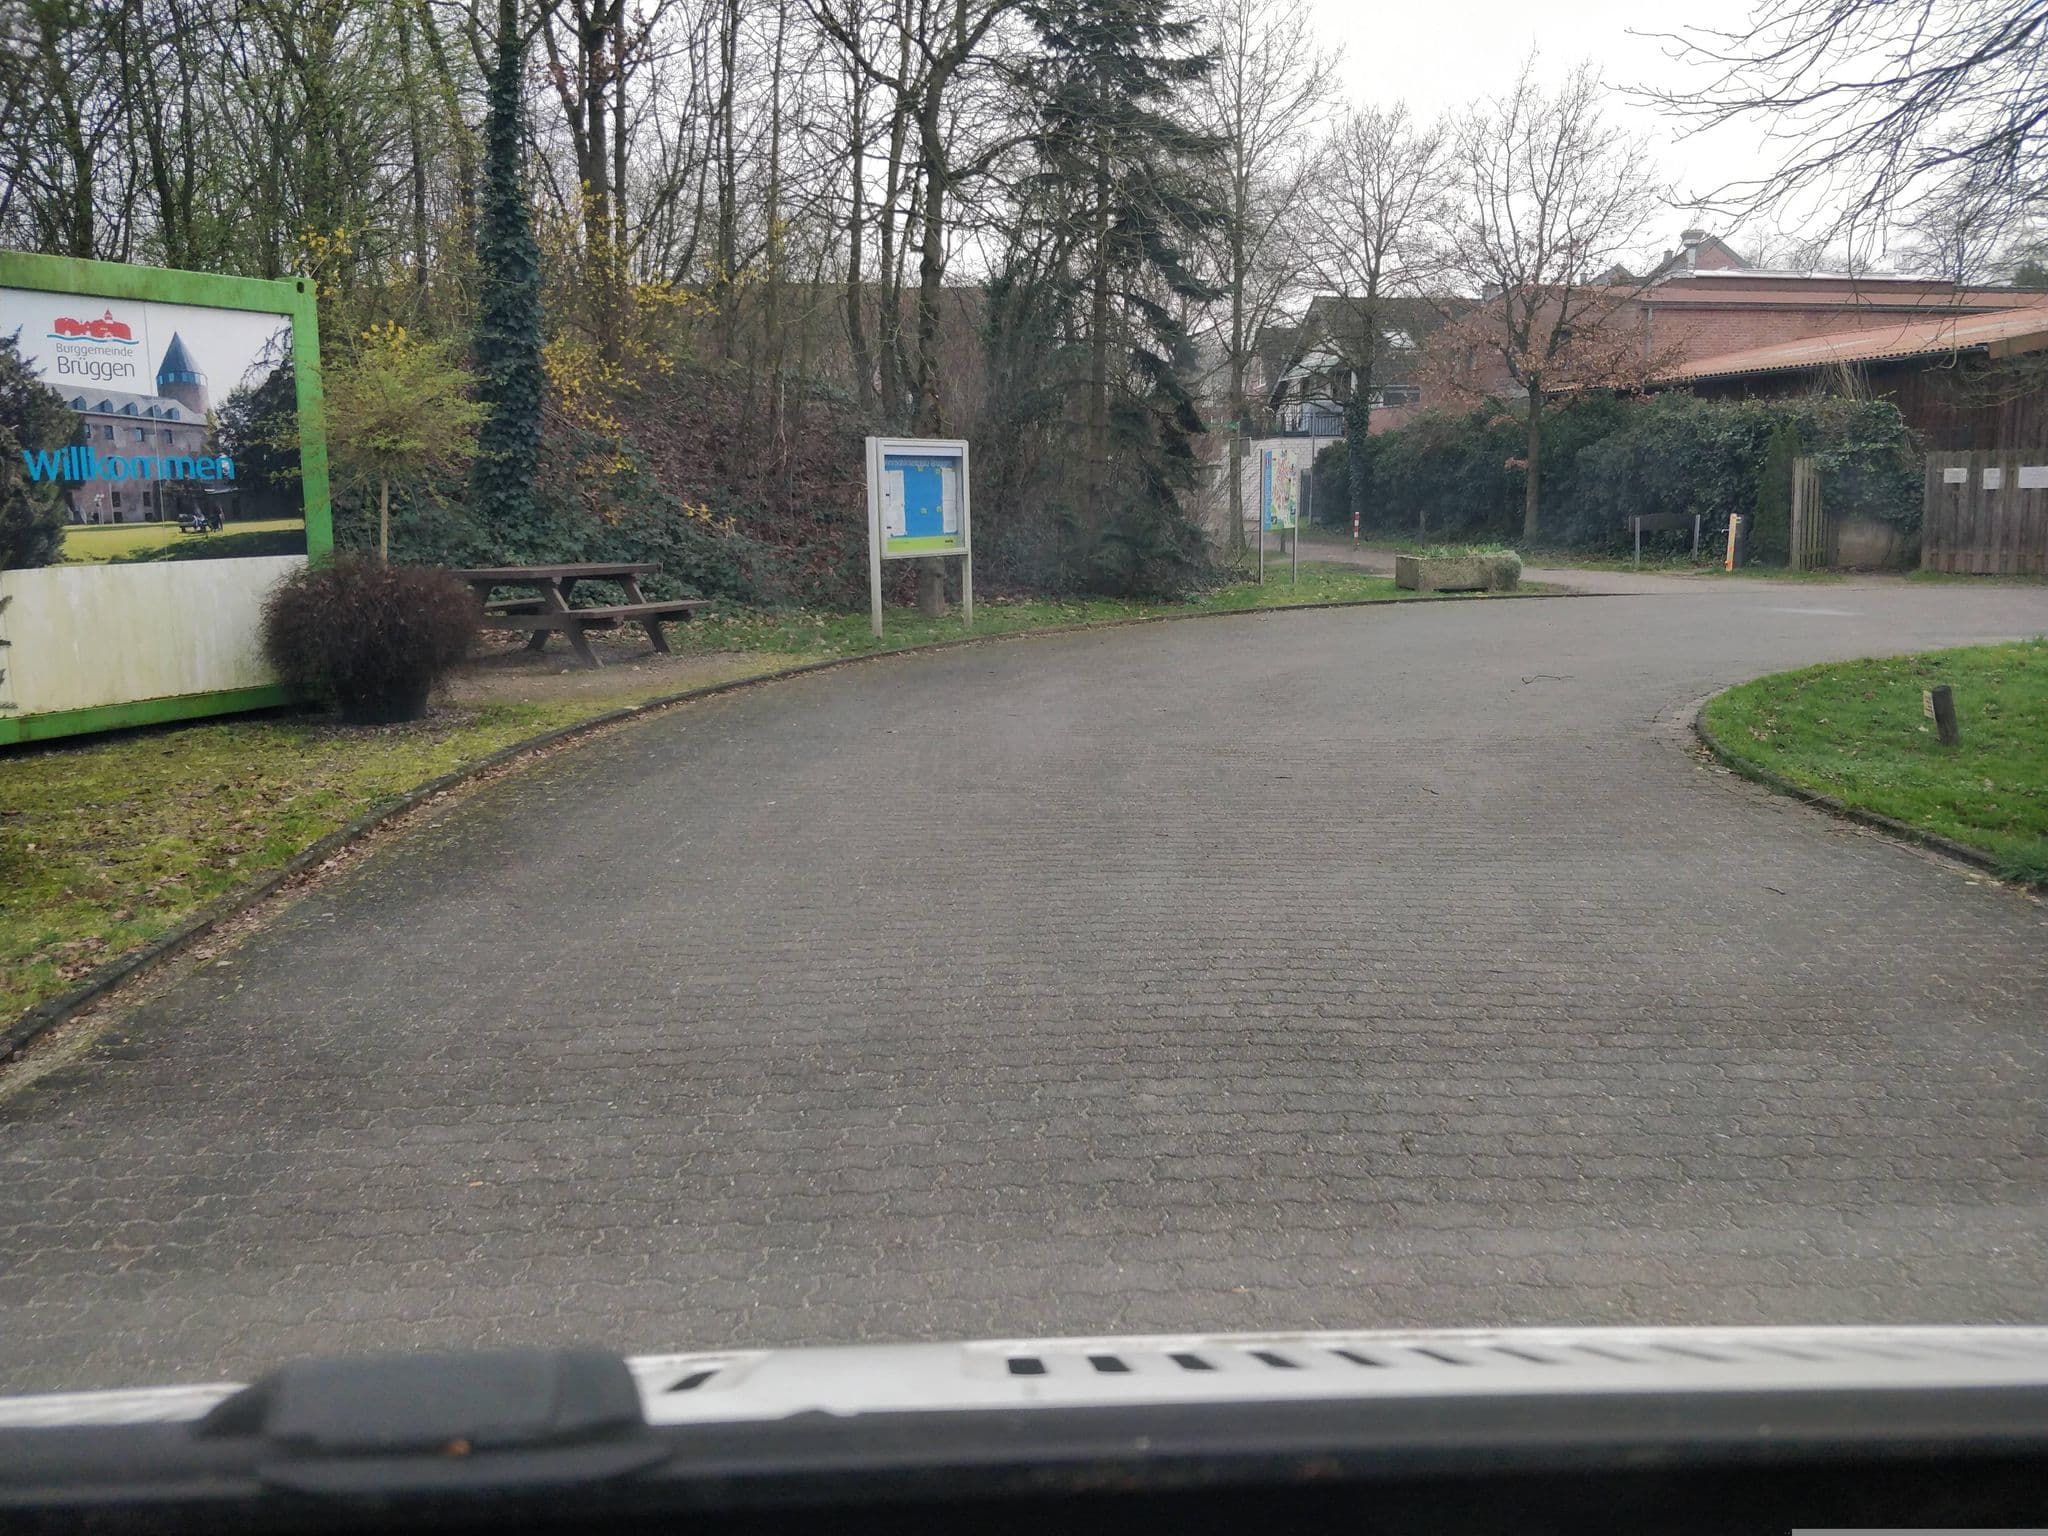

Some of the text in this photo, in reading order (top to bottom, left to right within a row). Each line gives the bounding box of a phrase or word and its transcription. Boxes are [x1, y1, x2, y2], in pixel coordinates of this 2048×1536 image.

[56, 343, 133, 357] Burggemeinde
[57, 357, 135, 381] Brüggen
[24, 446, 235, 482] Willkommen
